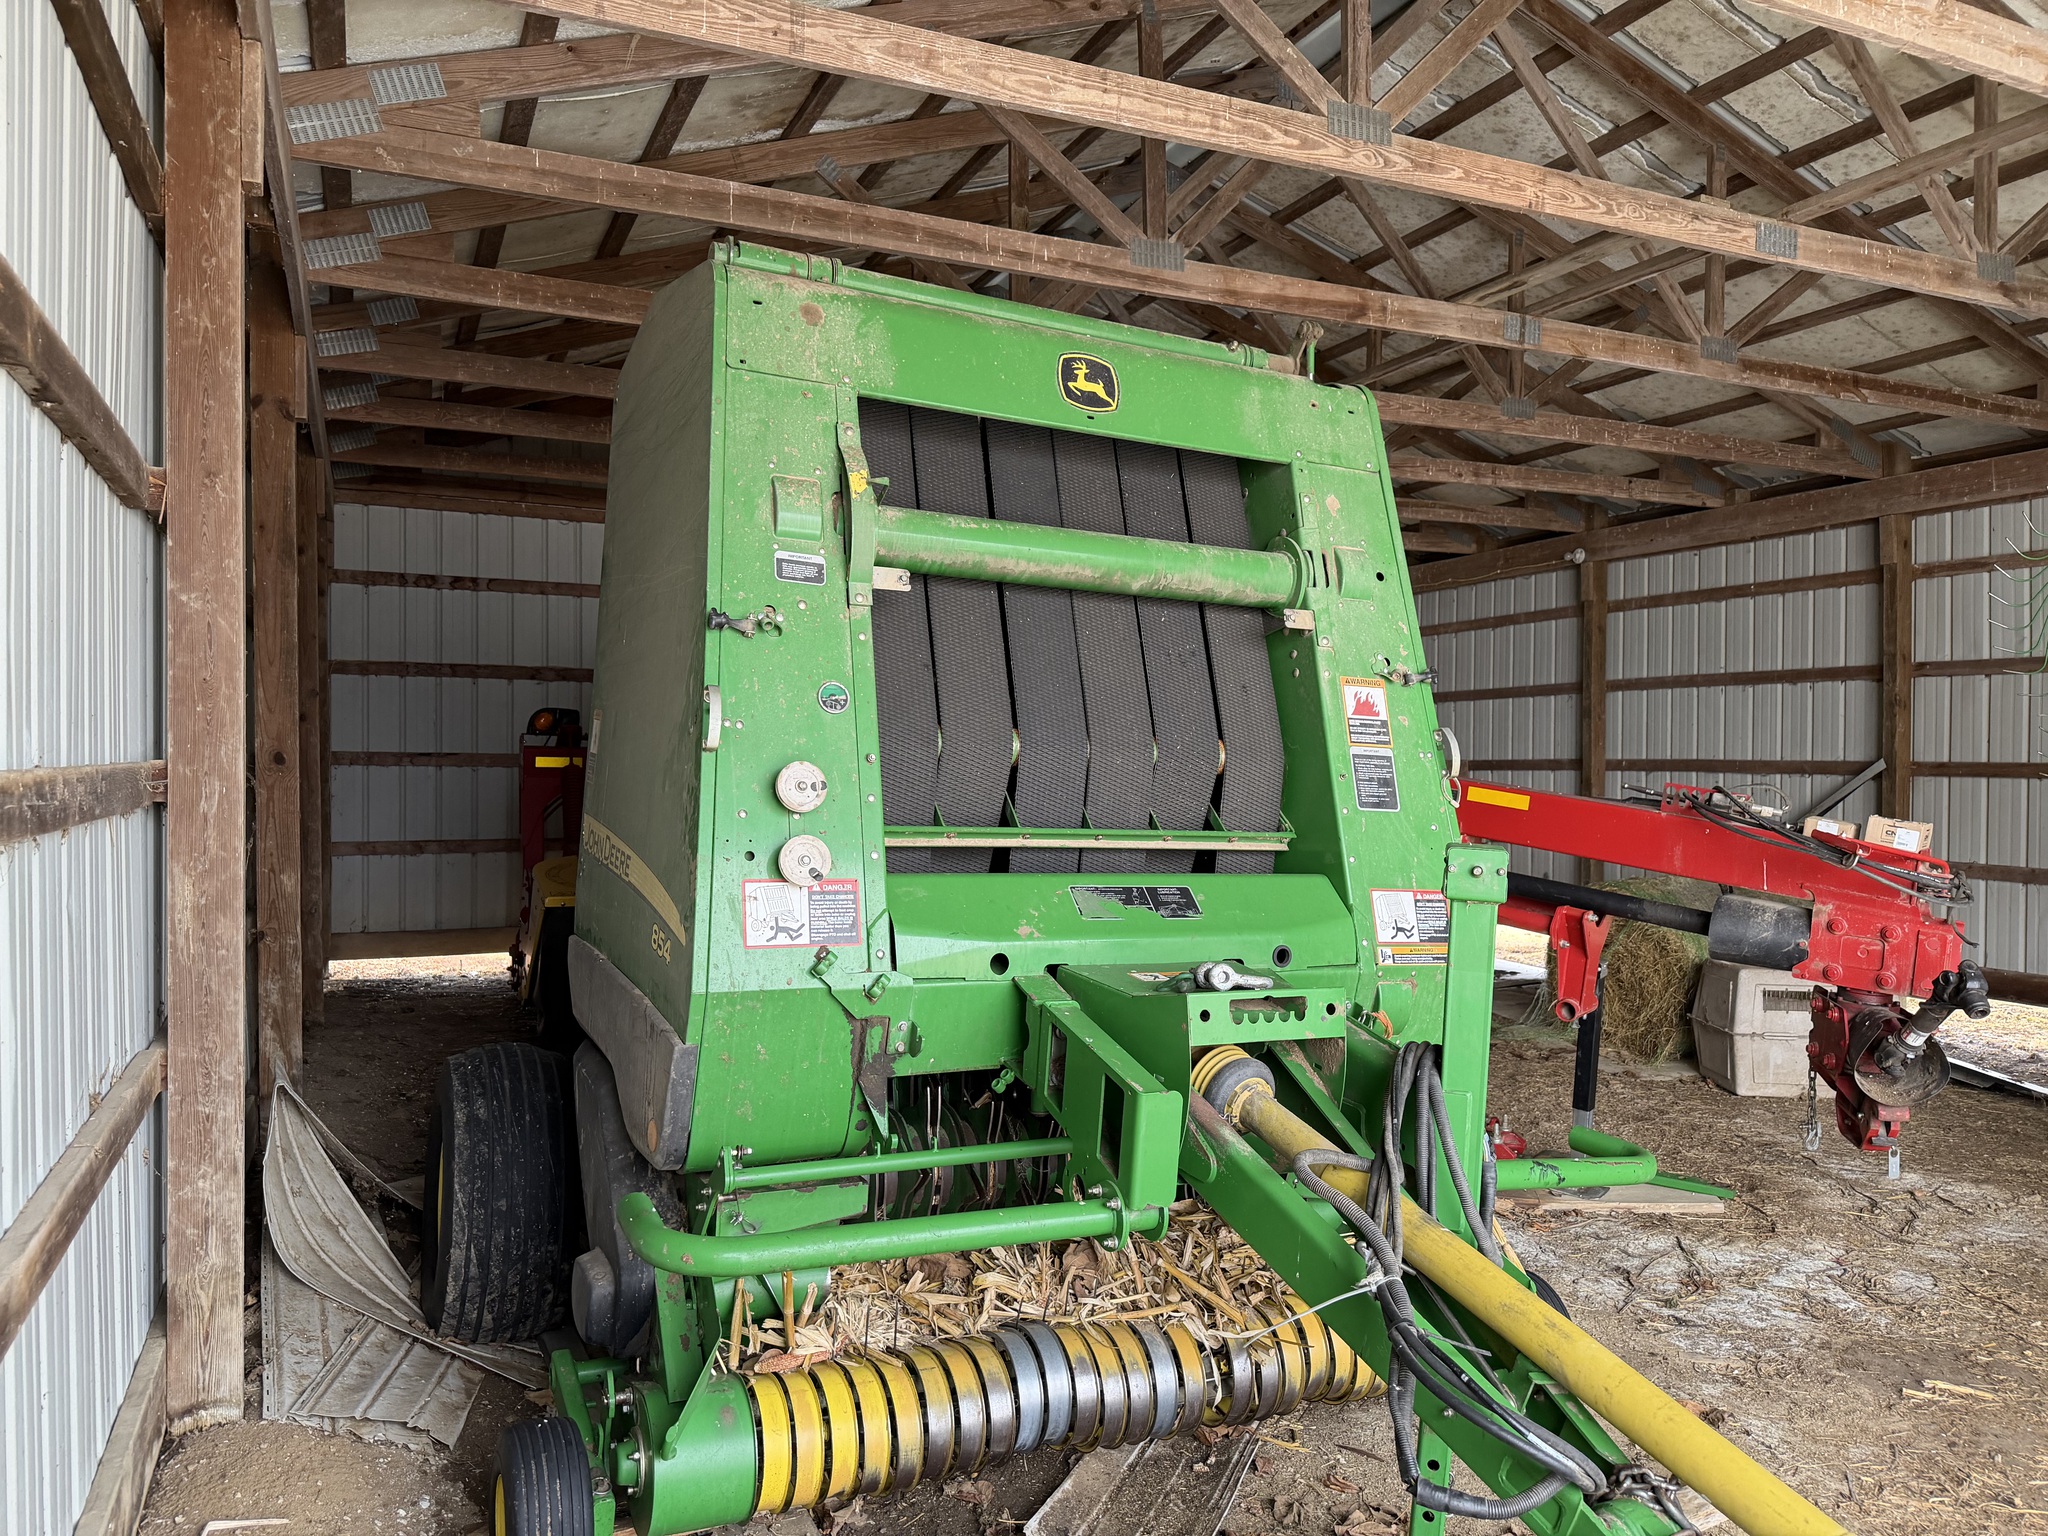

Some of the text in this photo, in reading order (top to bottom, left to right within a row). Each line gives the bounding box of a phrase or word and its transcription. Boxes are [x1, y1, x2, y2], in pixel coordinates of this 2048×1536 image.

[1349, 678, 1381, 686] WARNING
[584, 824, 632, 878] JOHN DEERE
[650, 923, 672, 966] 854
